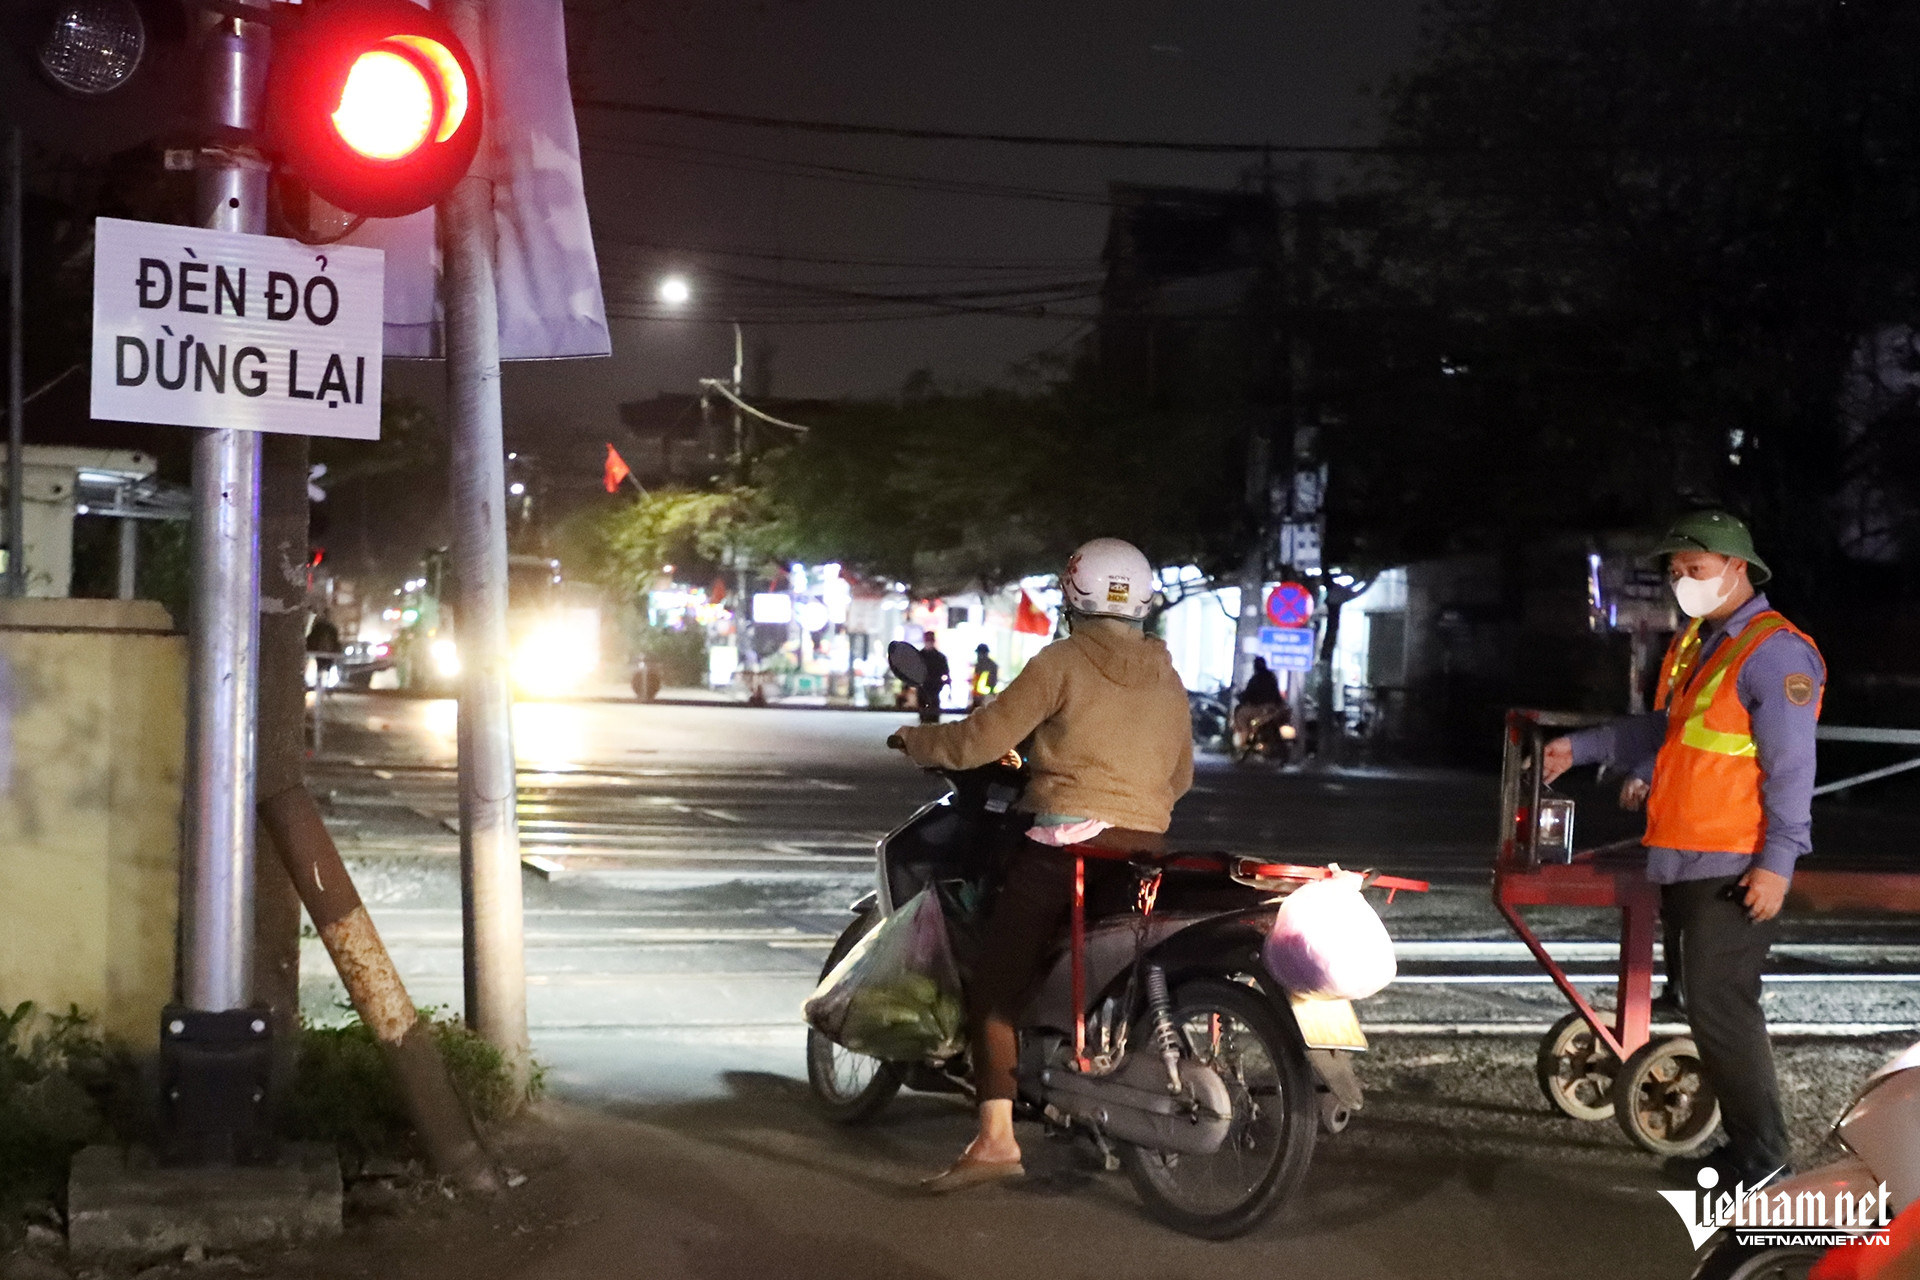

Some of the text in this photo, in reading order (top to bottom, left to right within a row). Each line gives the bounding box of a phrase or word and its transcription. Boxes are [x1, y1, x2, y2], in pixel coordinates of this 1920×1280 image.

[135, 247, 340, 327] ĐÈN ĐỎ
[115, 324, 366, 409] DỪNG LẠI
